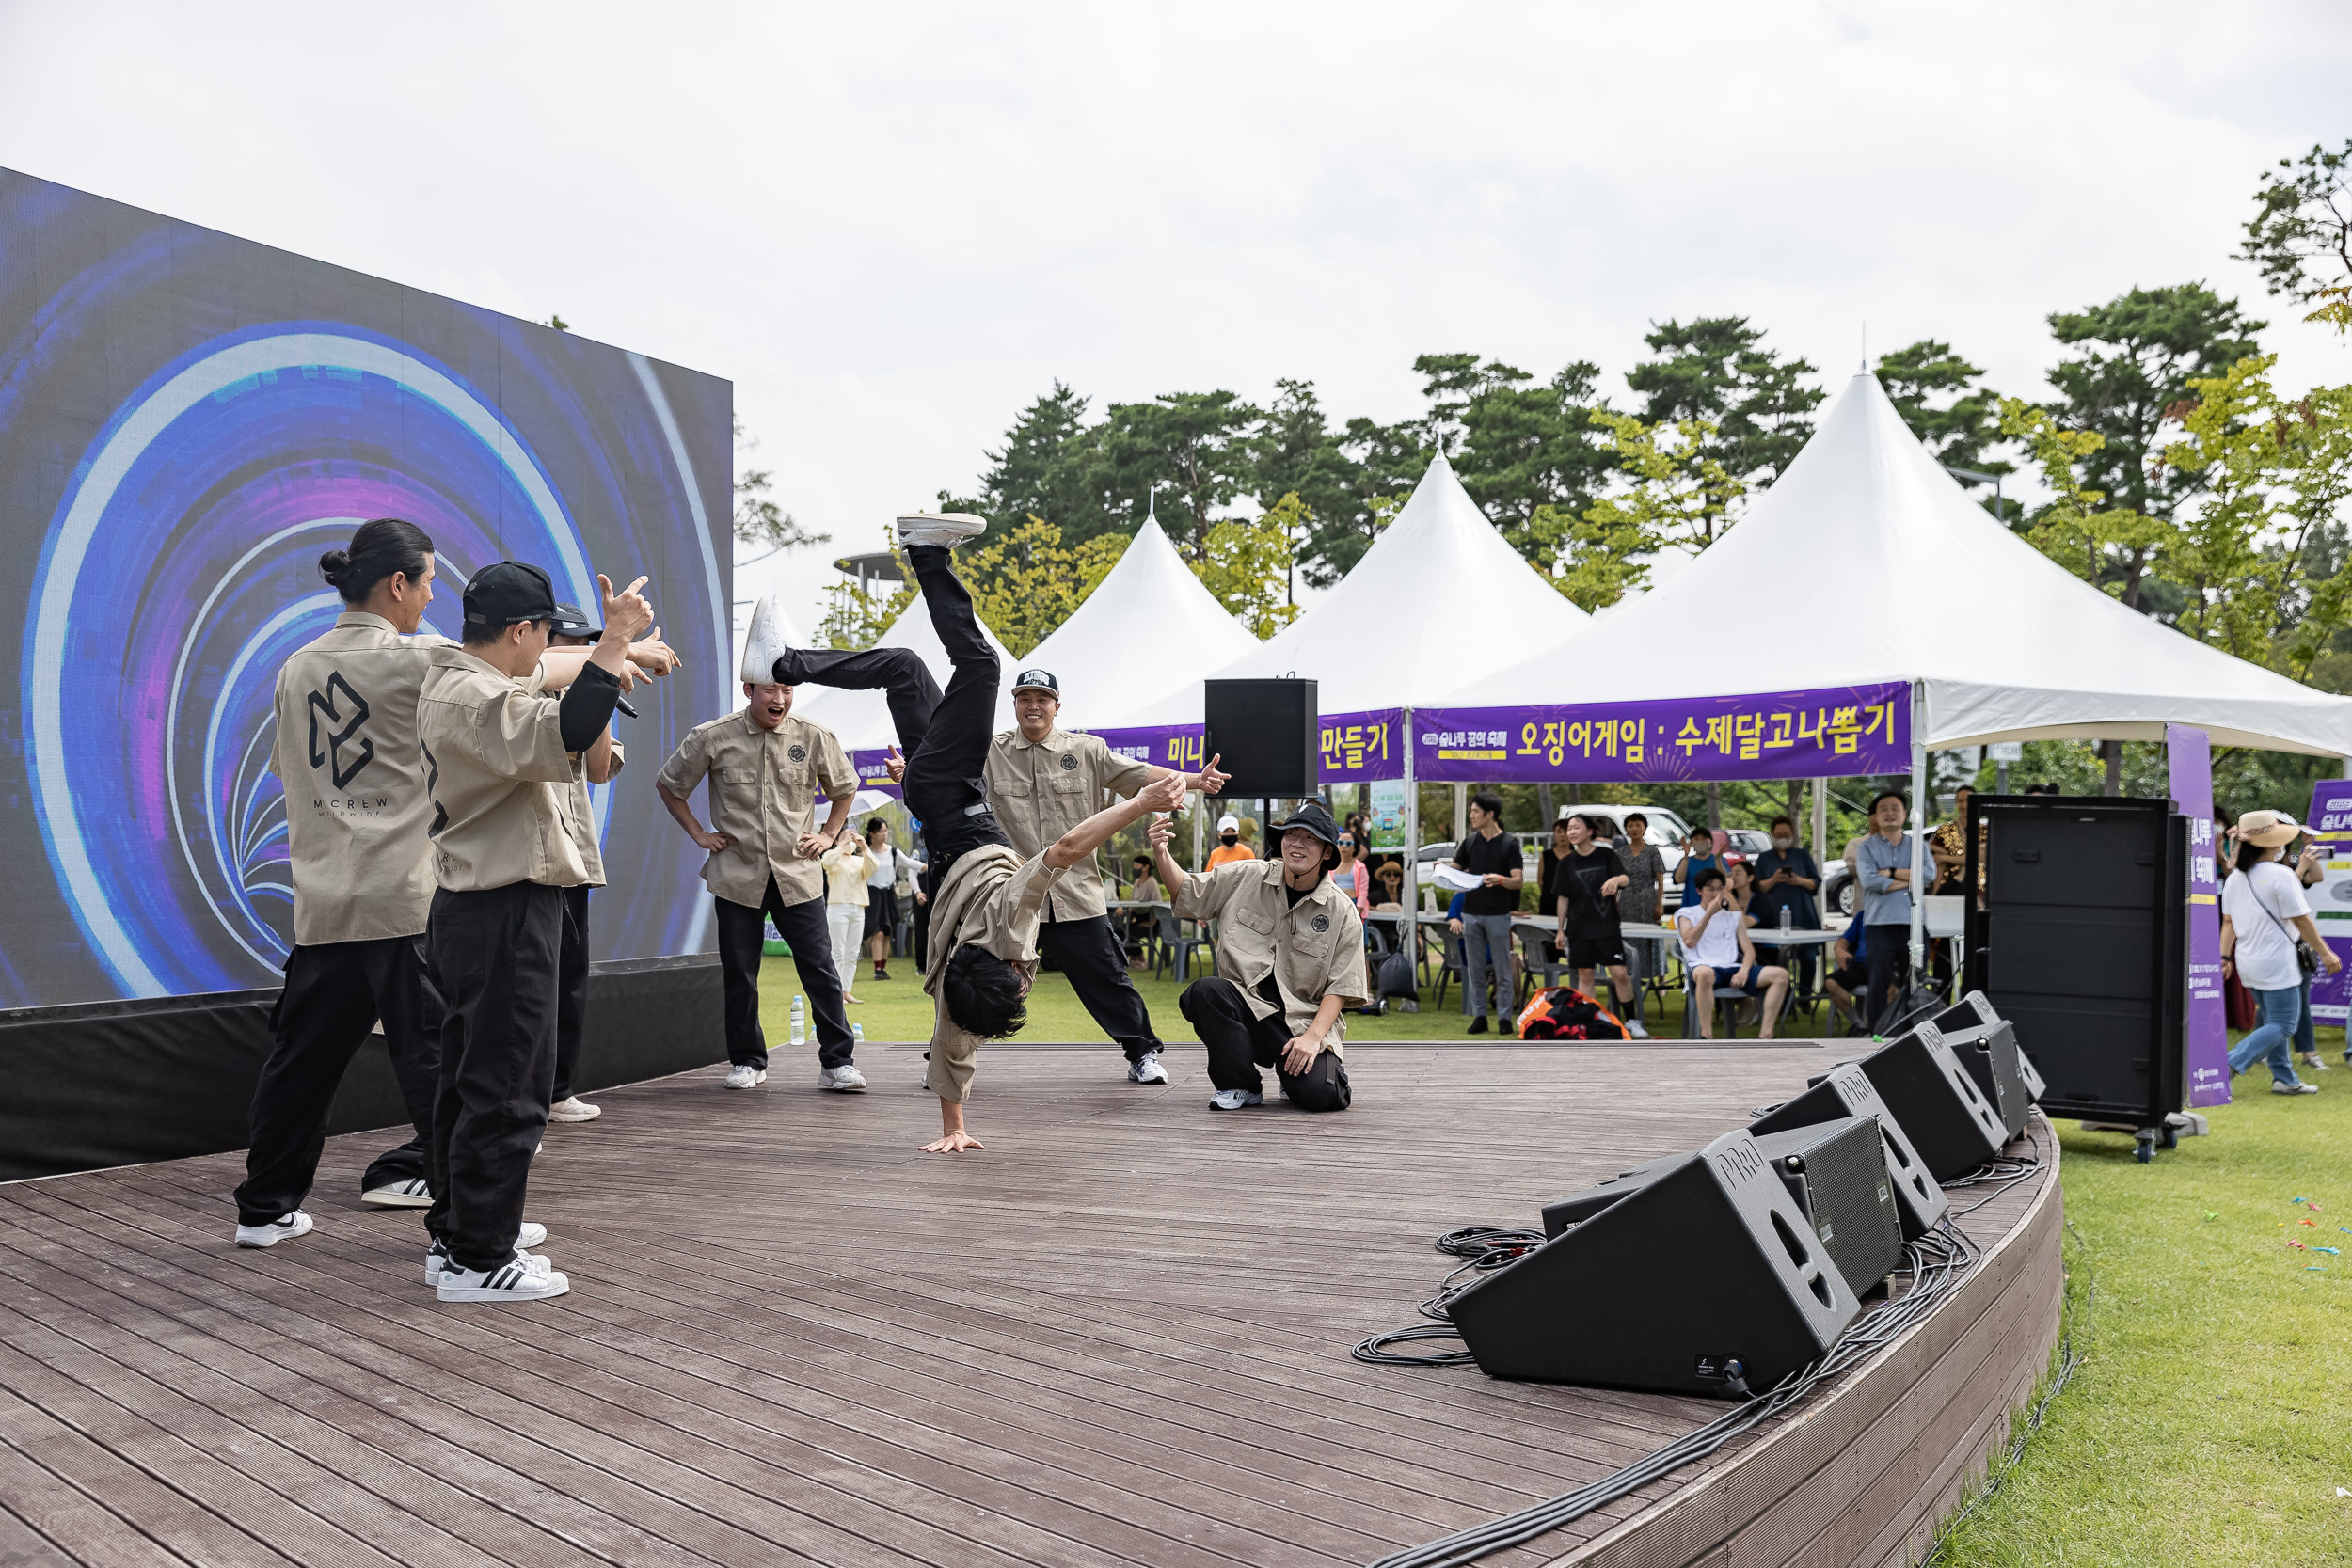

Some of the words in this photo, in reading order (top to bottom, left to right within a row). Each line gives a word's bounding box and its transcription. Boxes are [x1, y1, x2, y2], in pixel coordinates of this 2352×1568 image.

[1320, 722, 1388, 769] 만들기
[1516, 718, 1645, 767] 오징어게임
[1675, 701, 1895, 760] 수제달고나뽑기
